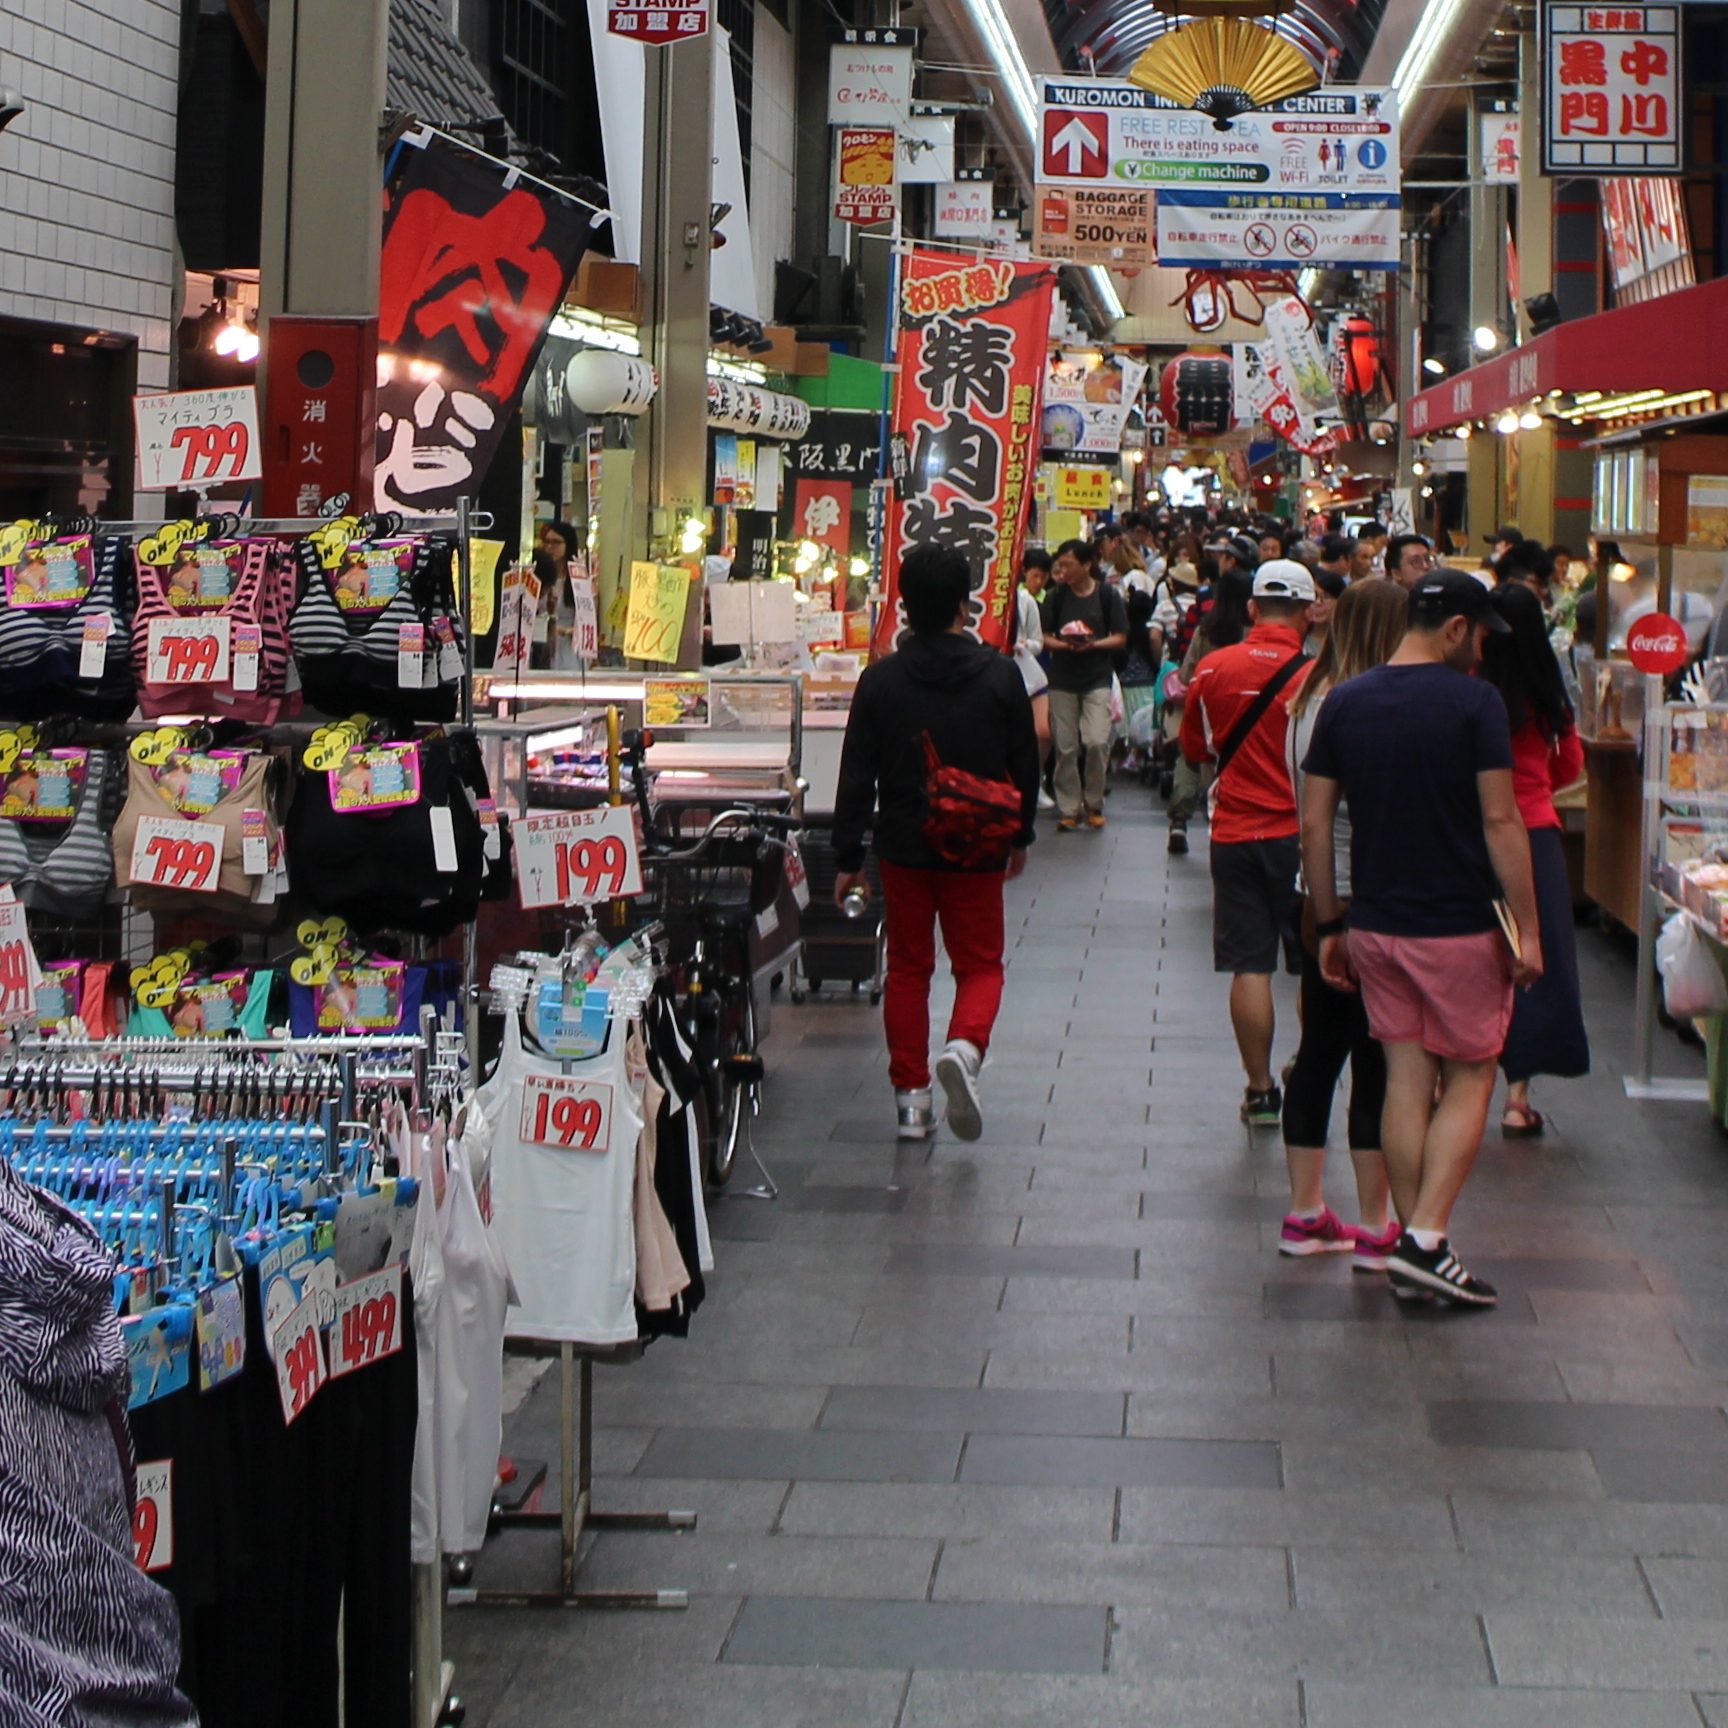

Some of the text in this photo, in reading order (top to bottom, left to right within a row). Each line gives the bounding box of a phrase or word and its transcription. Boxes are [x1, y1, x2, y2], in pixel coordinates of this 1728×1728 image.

[614, 11, 701, 33] 加盟店
[1559, 39, 1609, 138] 黒門
[1619, 39, 1669, 138] 中川
[1055, 87, 1145, 107] KUROMON
[1283, 97, 1346, 113] CENTER
[1120, 117, 1207, 135] FREE REST
[1283, 123, 1308, 132] OPEN
[1123, 135, 1260, 155] There is eating space
[1142, 162, 1258, 180] Change machine
[1280, 156, 1308, 170] FREE
[1279, 170, 1310, 183] Wi-Fi
[1318, 174, 1349, 184] TOILET
[839, 192, 892, 205] STAMP
[1075, 191, 1149, 204] BAGGAGE
[838, 206, 892, 217] 加盟店
[1075, 203, 1148, 217] STORAGE
[157, 403, 234, 426] マイティ ブラ
[170, 420, 249, 481] 799
[1066, 488, 1104, 498] Lunch
[159, 636, 218, 681] 799
[145, 835, 215, 888] 799
[554, 835, 627, 901] 199
[342, 1290, 396, 1367] 499
[284, 1324, 319, 1414] 399
